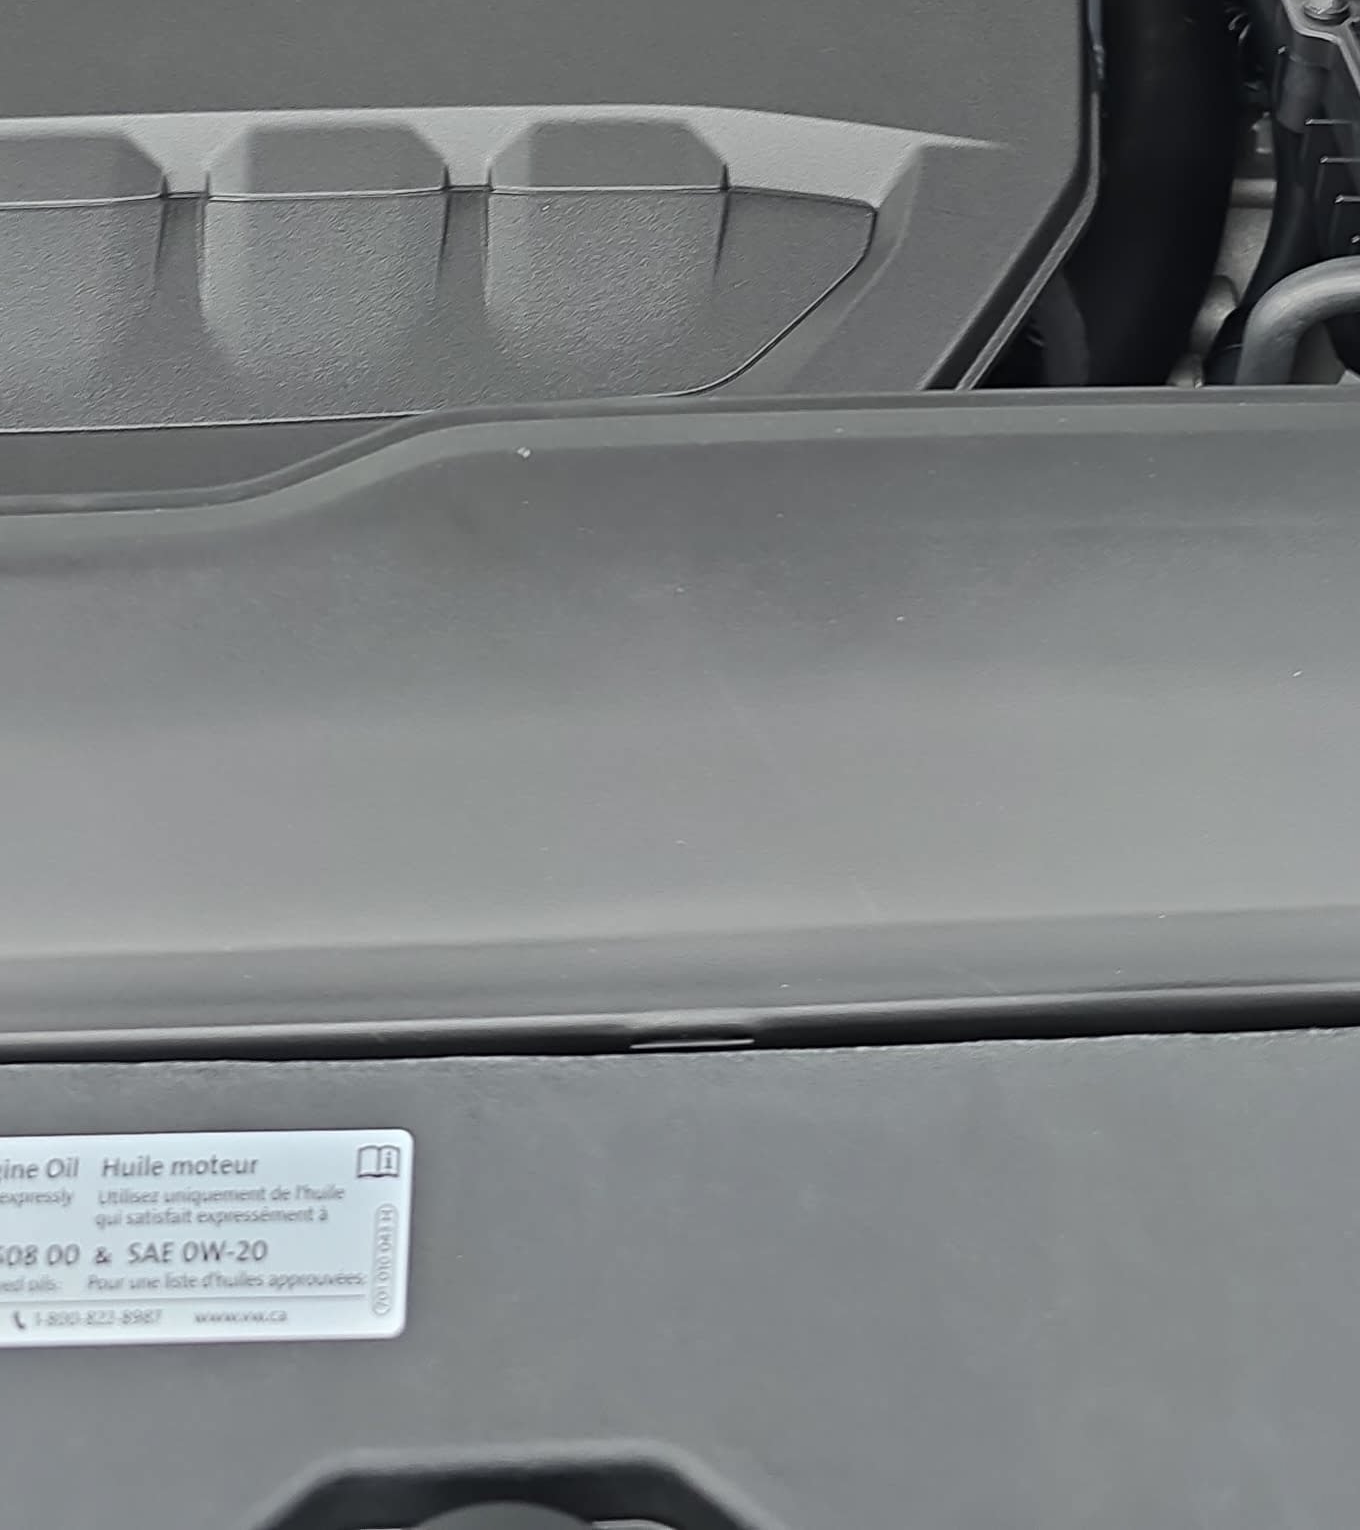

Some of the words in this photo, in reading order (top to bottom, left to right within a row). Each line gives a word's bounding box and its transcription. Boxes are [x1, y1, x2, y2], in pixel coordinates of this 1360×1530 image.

[45, 1156, 80, 1179] Oil
[101, 1155, 164, 1177] Huile
[169, 1155, 260, 1176] moteur
[98, 1186, 159, 1205] Utilisez
[164, 1185, 267, 1207] uniquement
[269, 1183, 291, 1201] de
[295, 1182, 346, 1201] l'huile
[95, 1211, 122, 1229] qui
[127, 1208, 192, 1227] satisfait
[196, 1206, 315, 1228] expressément
[318, 1205, 330, 1221] à
[46, 1243, 81, 1266] 00
[94, 1246, 112, 1264] &
[127, 1241, 175, 1265] SAE
[182, 1239, 269, 1263] 0W-20
[88, 1272, 124, 1290] Pour
[129, 1276, 160, 1290] une
[164, 1270, 199, 1288] liste
[202, 1269, 263, 1289] d'huiles
[194, 1308, 288, 1324] www.vw.ca
